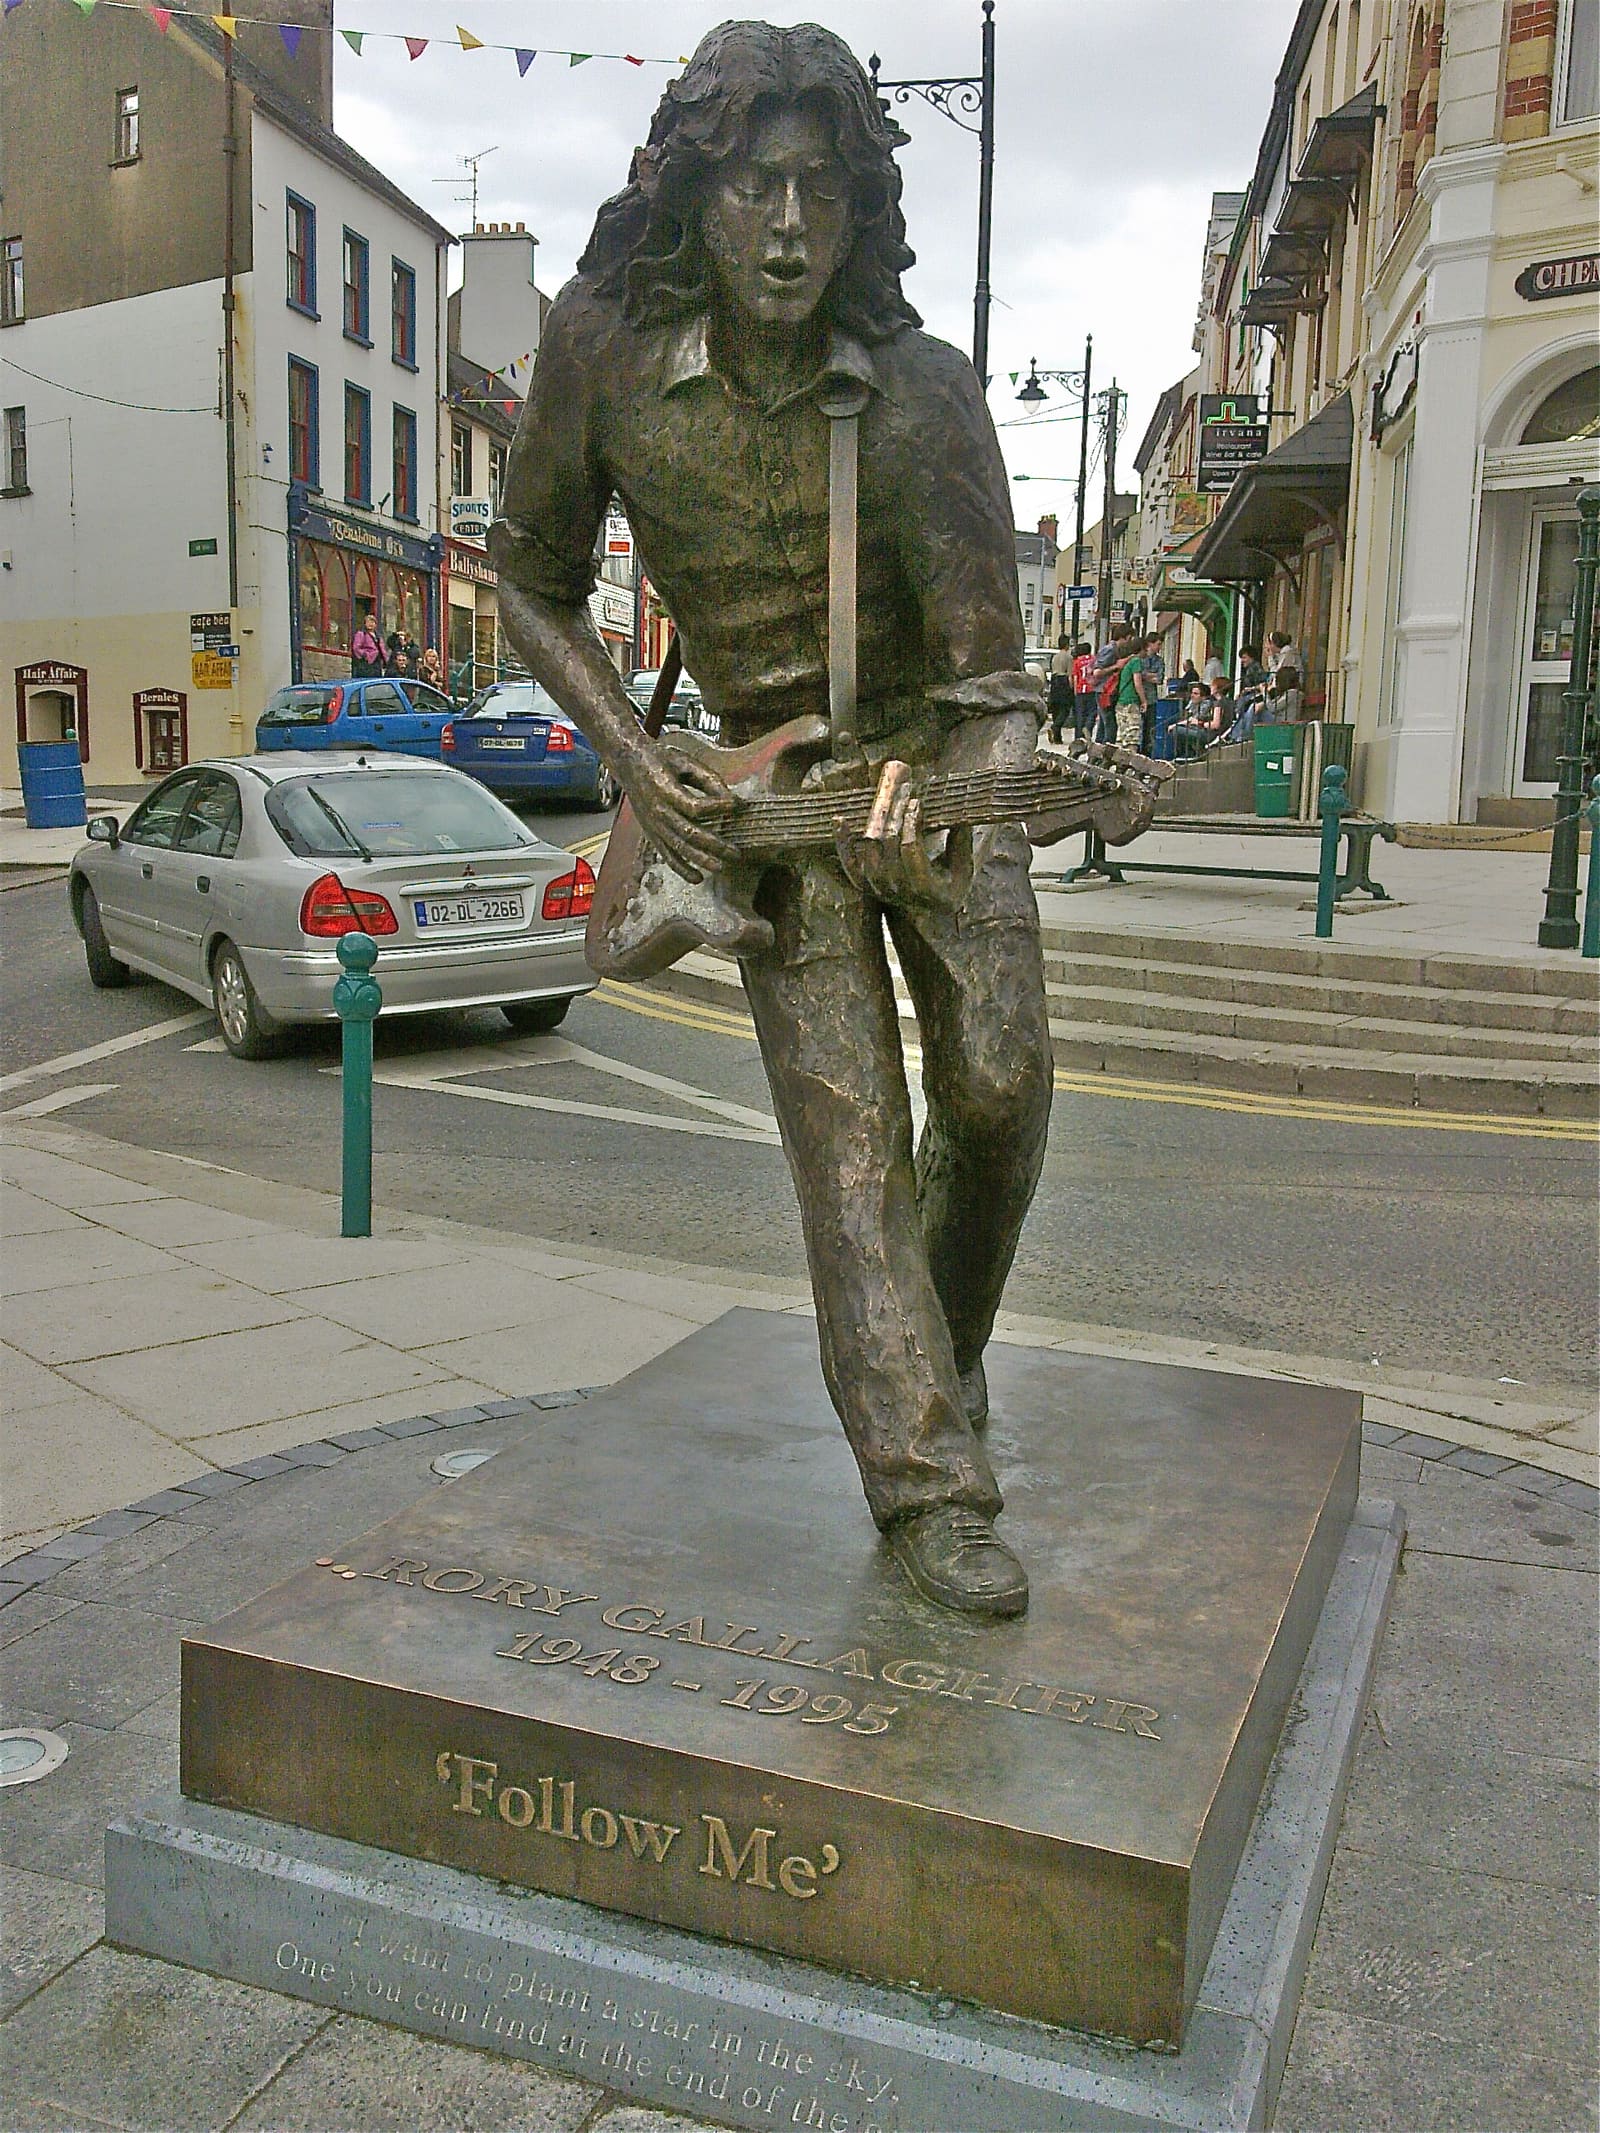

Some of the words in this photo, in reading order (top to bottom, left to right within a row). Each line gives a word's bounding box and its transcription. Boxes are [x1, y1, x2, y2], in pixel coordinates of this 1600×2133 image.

[452, 502, 489, 518] SPORTS
[23, 667, 47, 679] Hair
[48, 665, 79, 679] Affair
[430, 900, 519, 924] 02-DL-2266
[361, 1555, 599, 1617] RORY
[602, 1603, 1162, 1741] GALLAGHER
[496, 1631, 661, 1685] 1948
[720, 1678, 899, 1735] 1995
[276, 1942, 336, 1983] One
[342, 1970, 401, 2003] you
[414, 1990, 467, 2024] can
[480, 2002, 549, 2046] find
[557, 2034, 589, 2059] at
[600, 2041, 652, 2077] the
[666, 2064, 730, 2100] end
[742, 2085, 785, 2114] of
[791, 2096, 849, 2133] the
[379, 1933, 450, 1973] want
[463, 1955, 495, 1984] to
[503, 1971, 592, 2013] plant
[602, 1999, 619, 2021] a
[631, 2009, 699, 2042] star
[708, 2025, 742, 2056] in
[756, 2038, 815, 2075] the
[825, 2058, 900, 2105] sky,
